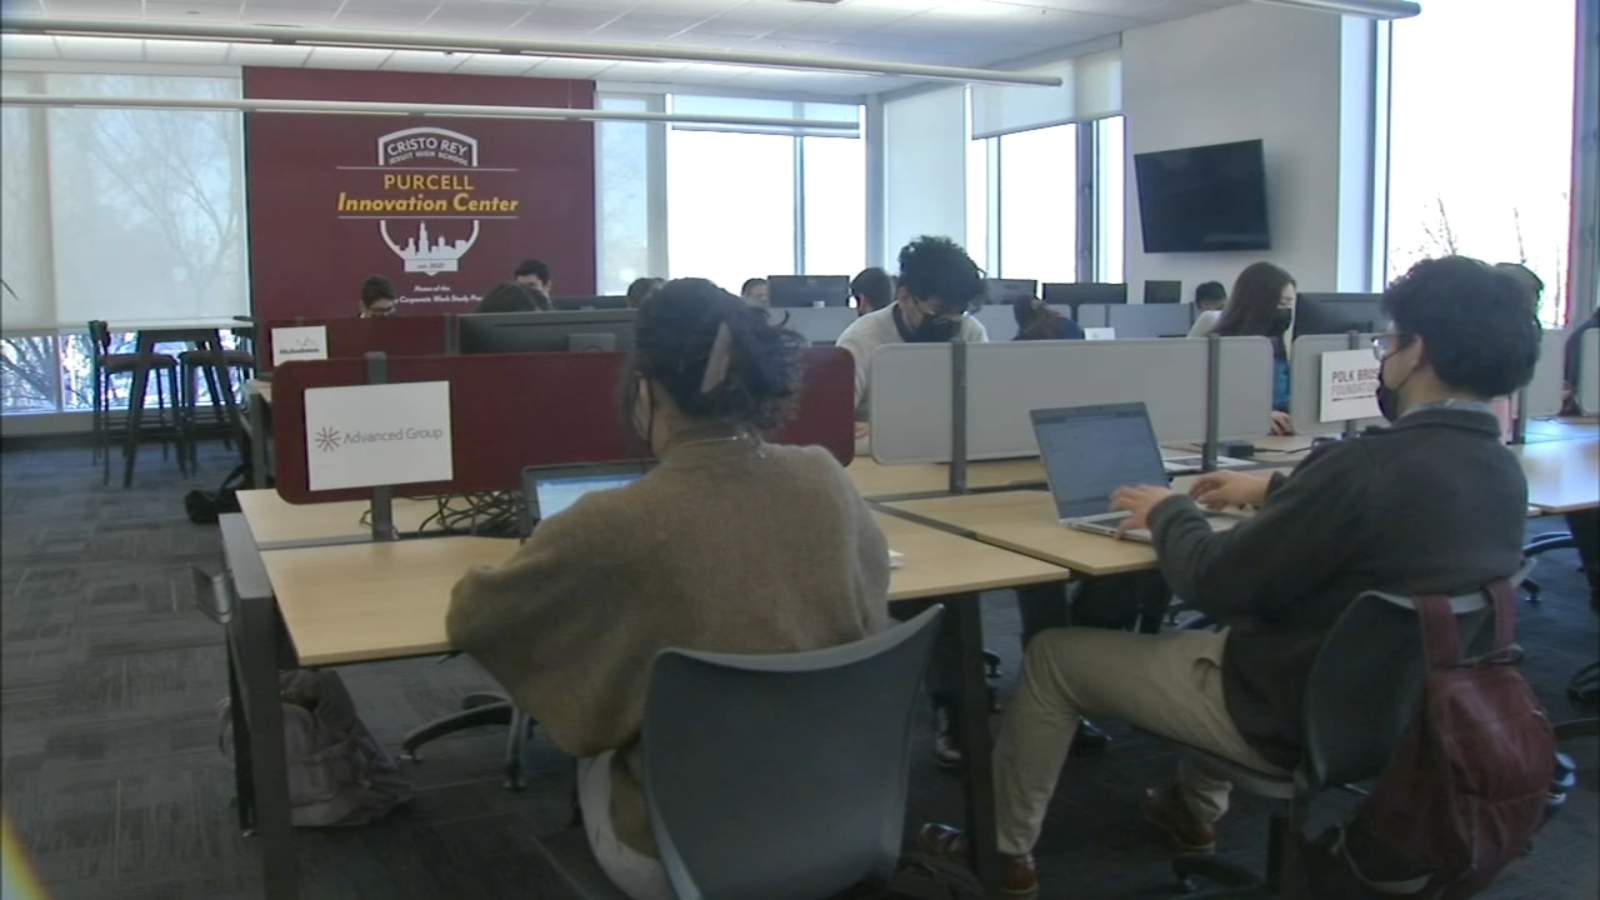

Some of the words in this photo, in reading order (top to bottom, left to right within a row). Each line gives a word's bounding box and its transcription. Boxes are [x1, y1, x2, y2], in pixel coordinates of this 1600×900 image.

[387, 137, 437, 155] CRISTO
[440, 139, 468, 156] REY
[384, 174, 474, 190] PURCELL
[337, 192, 447, 211] Innovation
[453, 192, 519, 211] Center
[1331, 370, 1355, 383] POLK
[343, 428, 403, 444] Advanced
[405, 427, 443, 441] Group
